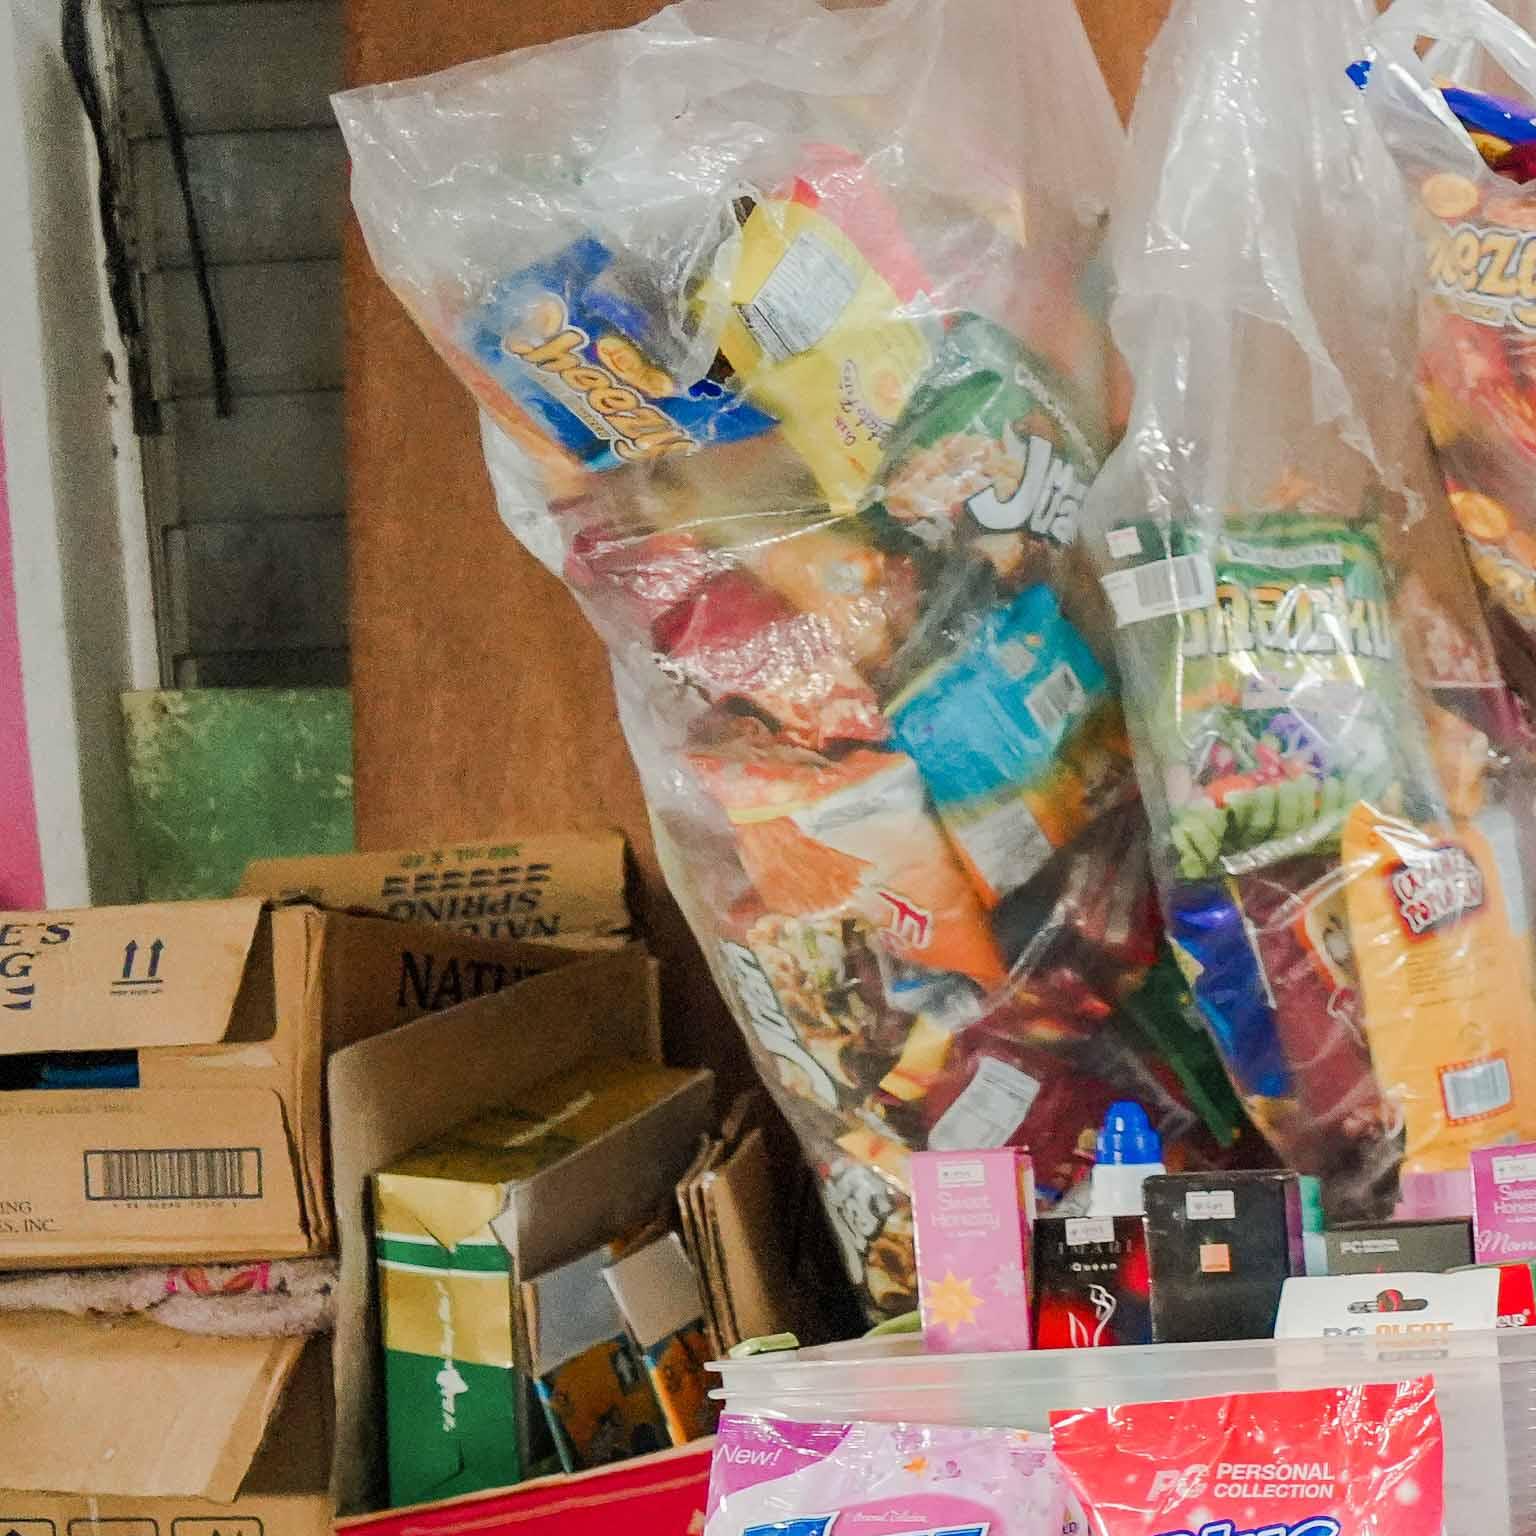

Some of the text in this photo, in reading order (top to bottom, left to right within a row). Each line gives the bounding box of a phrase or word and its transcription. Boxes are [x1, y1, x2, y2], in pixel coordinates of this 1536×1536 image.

[714, 1443, 784, 1468] New!
[1215, 1461, 1336, 1483] PERSONAL
[1213, 1482, 1335, 1500] COLLECTION
